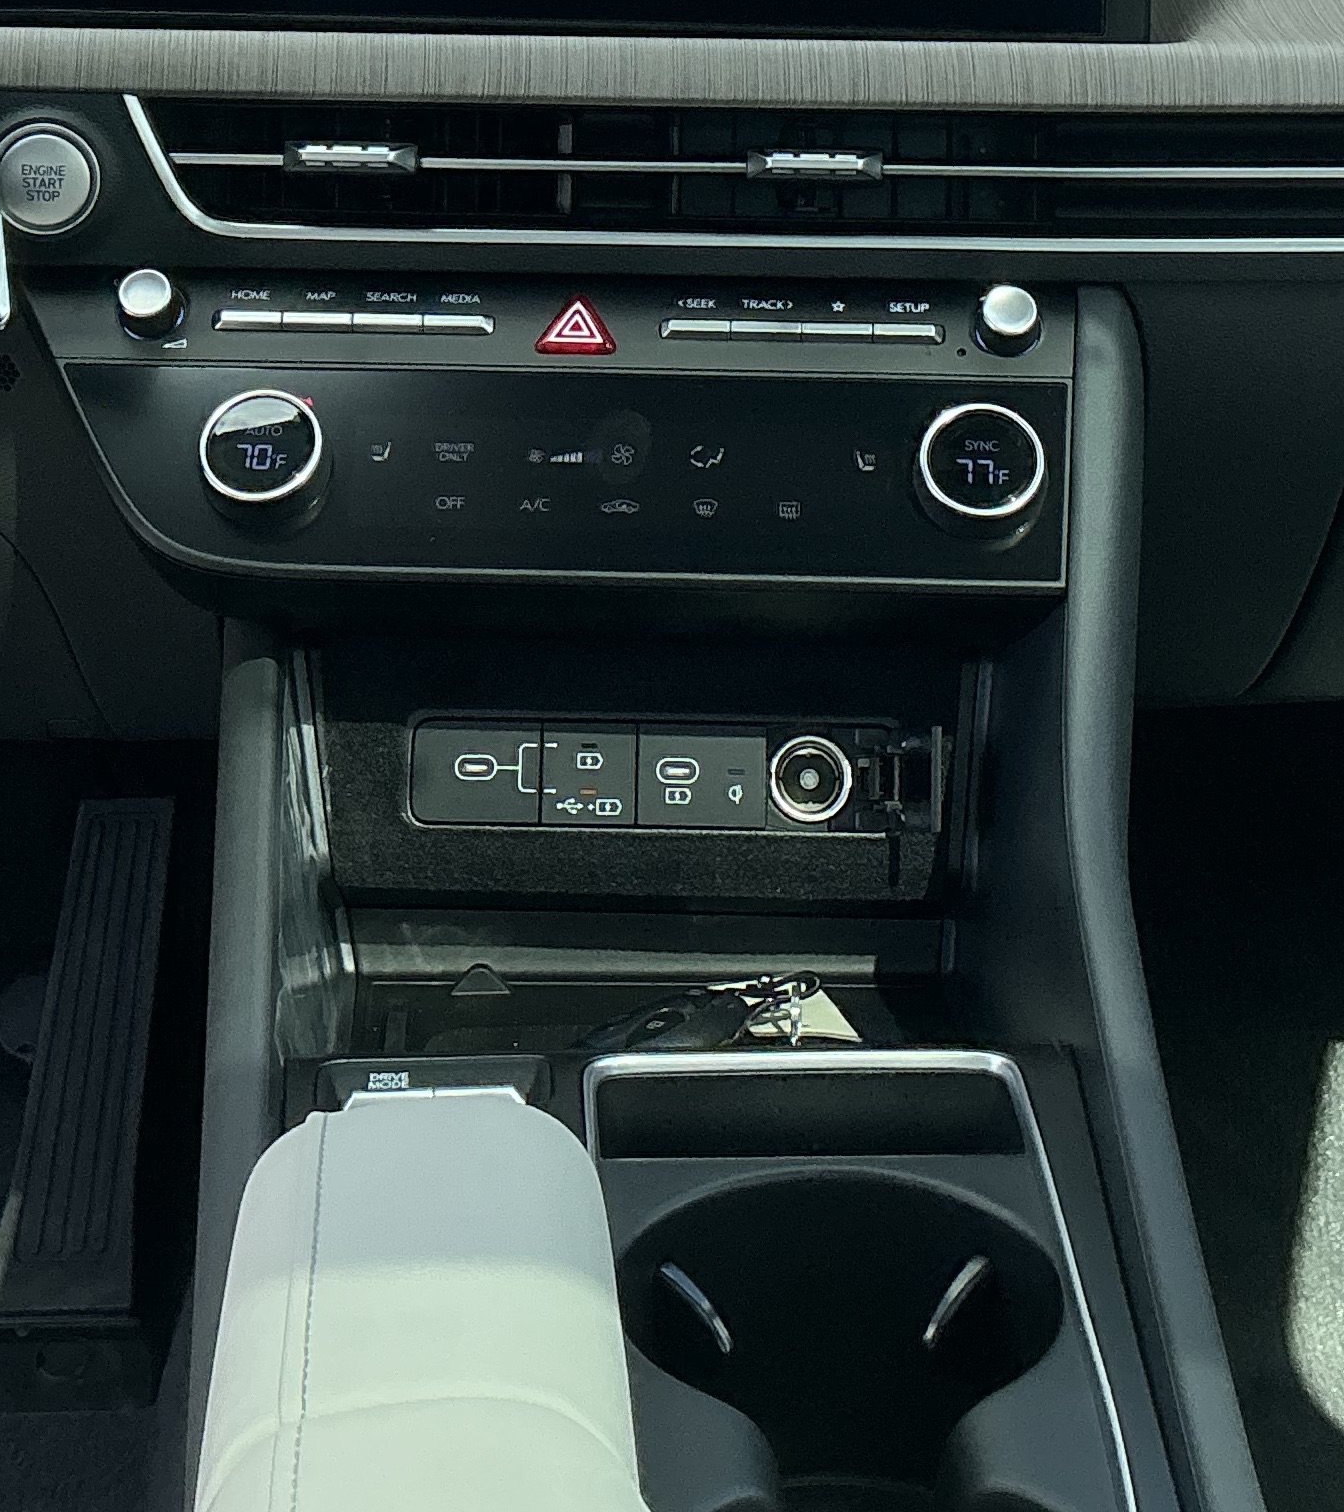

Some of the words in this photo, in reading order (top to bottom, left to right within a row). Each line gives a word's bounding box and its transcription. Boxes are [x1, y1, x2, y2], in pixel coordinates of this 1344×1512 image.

[21, 164, 67, 177] ENGINE
[22, 177, 65, 190] START
[25, 189, 61, 202] STOP
[230, 289, 272, 301] HOME
[305, 290, 337, 302] MAP
[365, 291, 418, 304] SEARCH
[439, 292, 481, 305] MEDIA
[889, 300, 931, 314] SETUP
[244, 425, 284, 437] AUTO
[434, 442, 475, 452] DRIVER
[964, 438, 1000, 452] SYNC
[438, 451, 471, 462] ONLY
[435, 496, 467, 510] OFF
[519, 497, 552, 512] A/C
[368, 1071, 410, 1081] DRIVE
[367, 1080, 410, 1090] MODE
